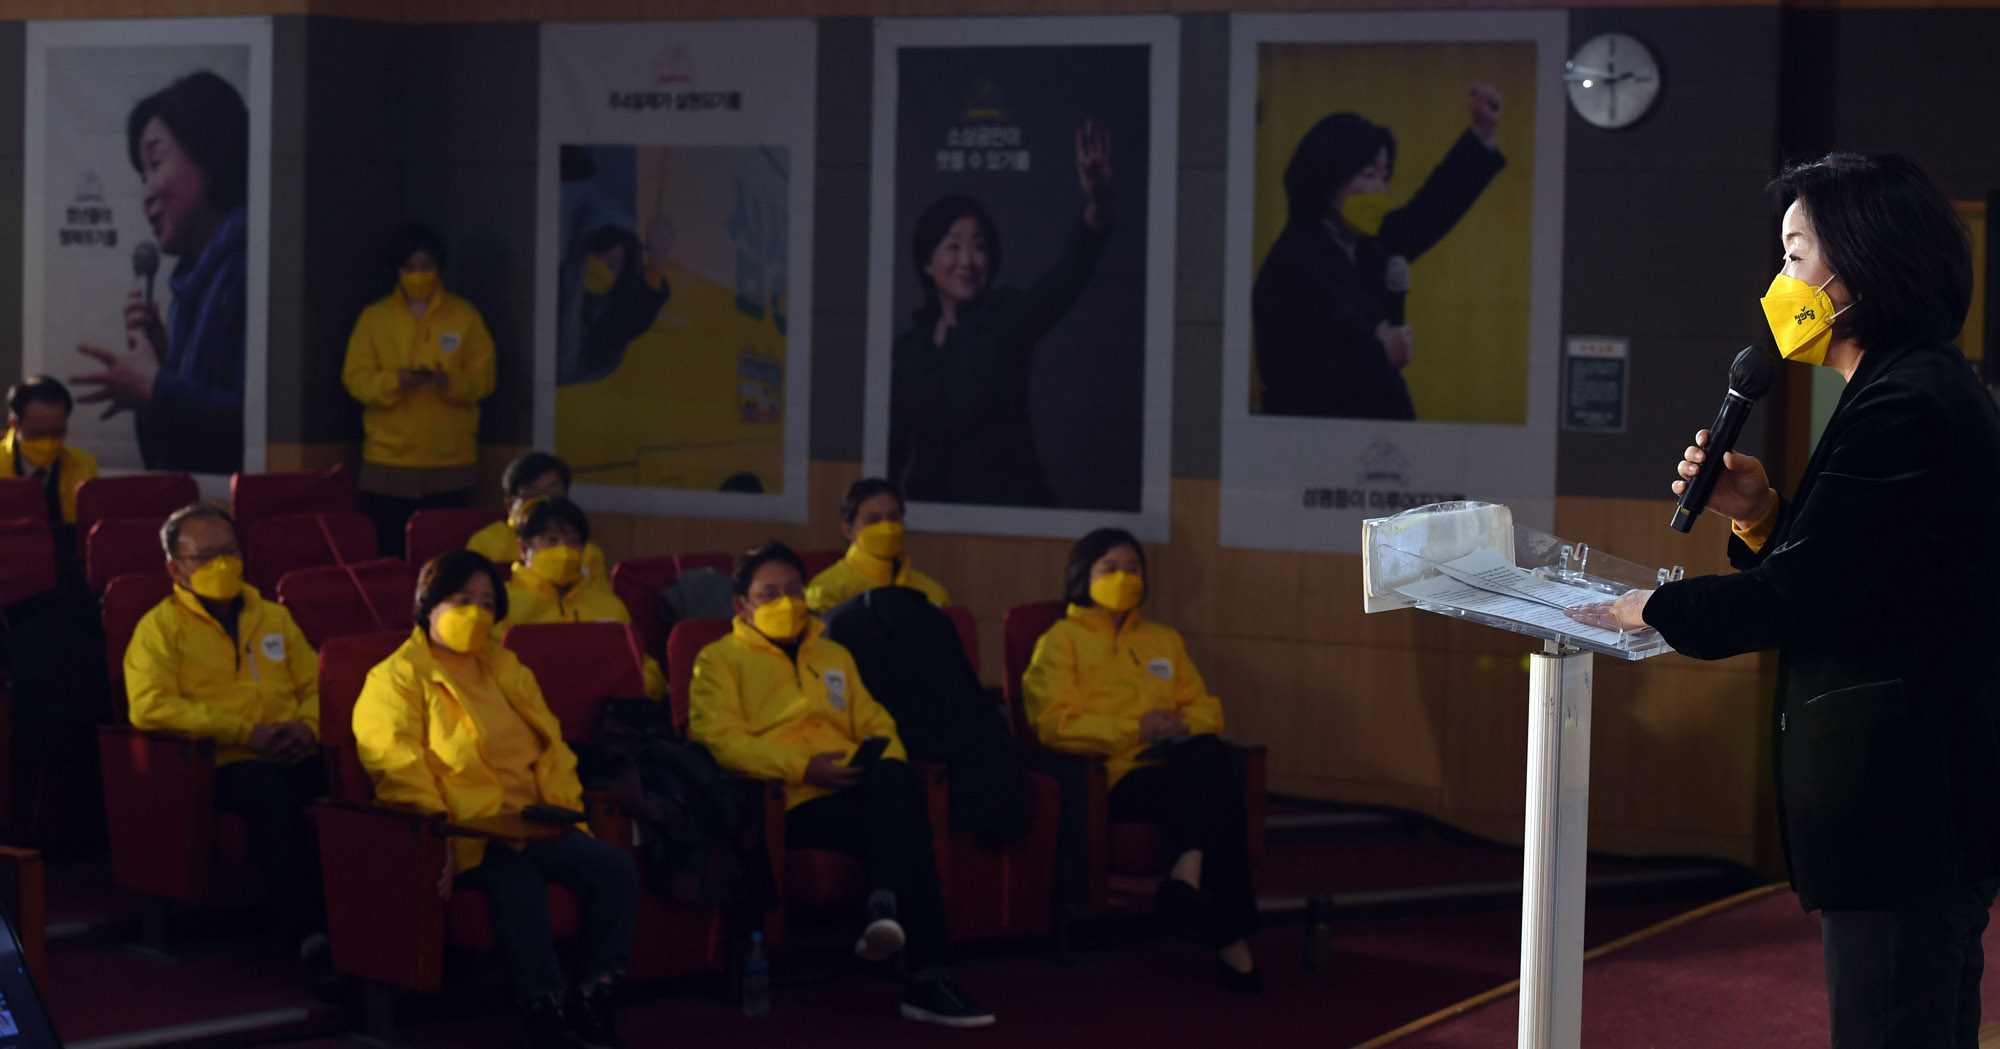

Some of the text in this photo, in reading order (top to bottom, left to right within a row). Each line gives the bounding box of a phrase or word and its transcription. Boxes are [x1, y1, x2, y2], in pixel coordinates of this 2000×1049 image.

[947, 126, 1021, 147] 소상공인이
[967, 150, 982, 170] 수
[1794, 306, 1815, 325] 정의당
[1302, 488, 1365, 508] 성평등이
